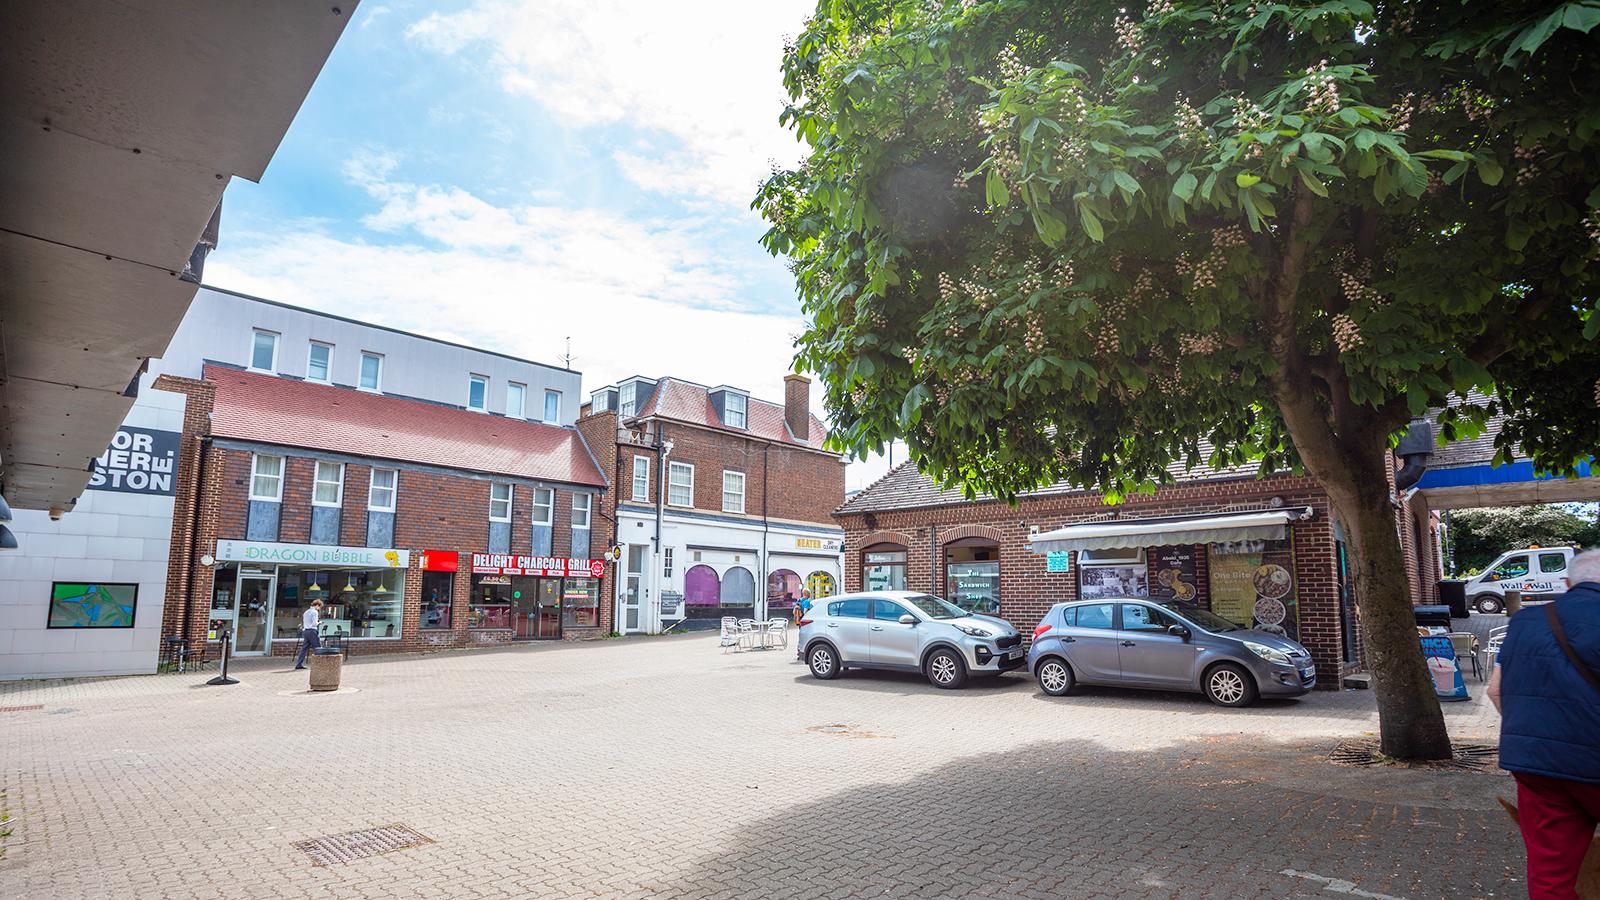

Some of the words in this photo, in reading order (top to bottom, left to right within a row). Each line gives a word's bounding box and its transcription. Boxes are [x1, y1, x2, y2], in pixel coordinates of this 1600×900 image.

[88, 467, 171, 492] STON
[247, 546, 317, 561] DRAGON
[322, 550, 373, 563] BUBBLE
[473, 553, 513, 568] DELIGHT
[517, 556, 565, 570] CHARCOAL
[567, 559, 591, 571] GRILL
[1500, 582, 1523, 590] Wall
[1530, 582, 1553, 590] Wall
